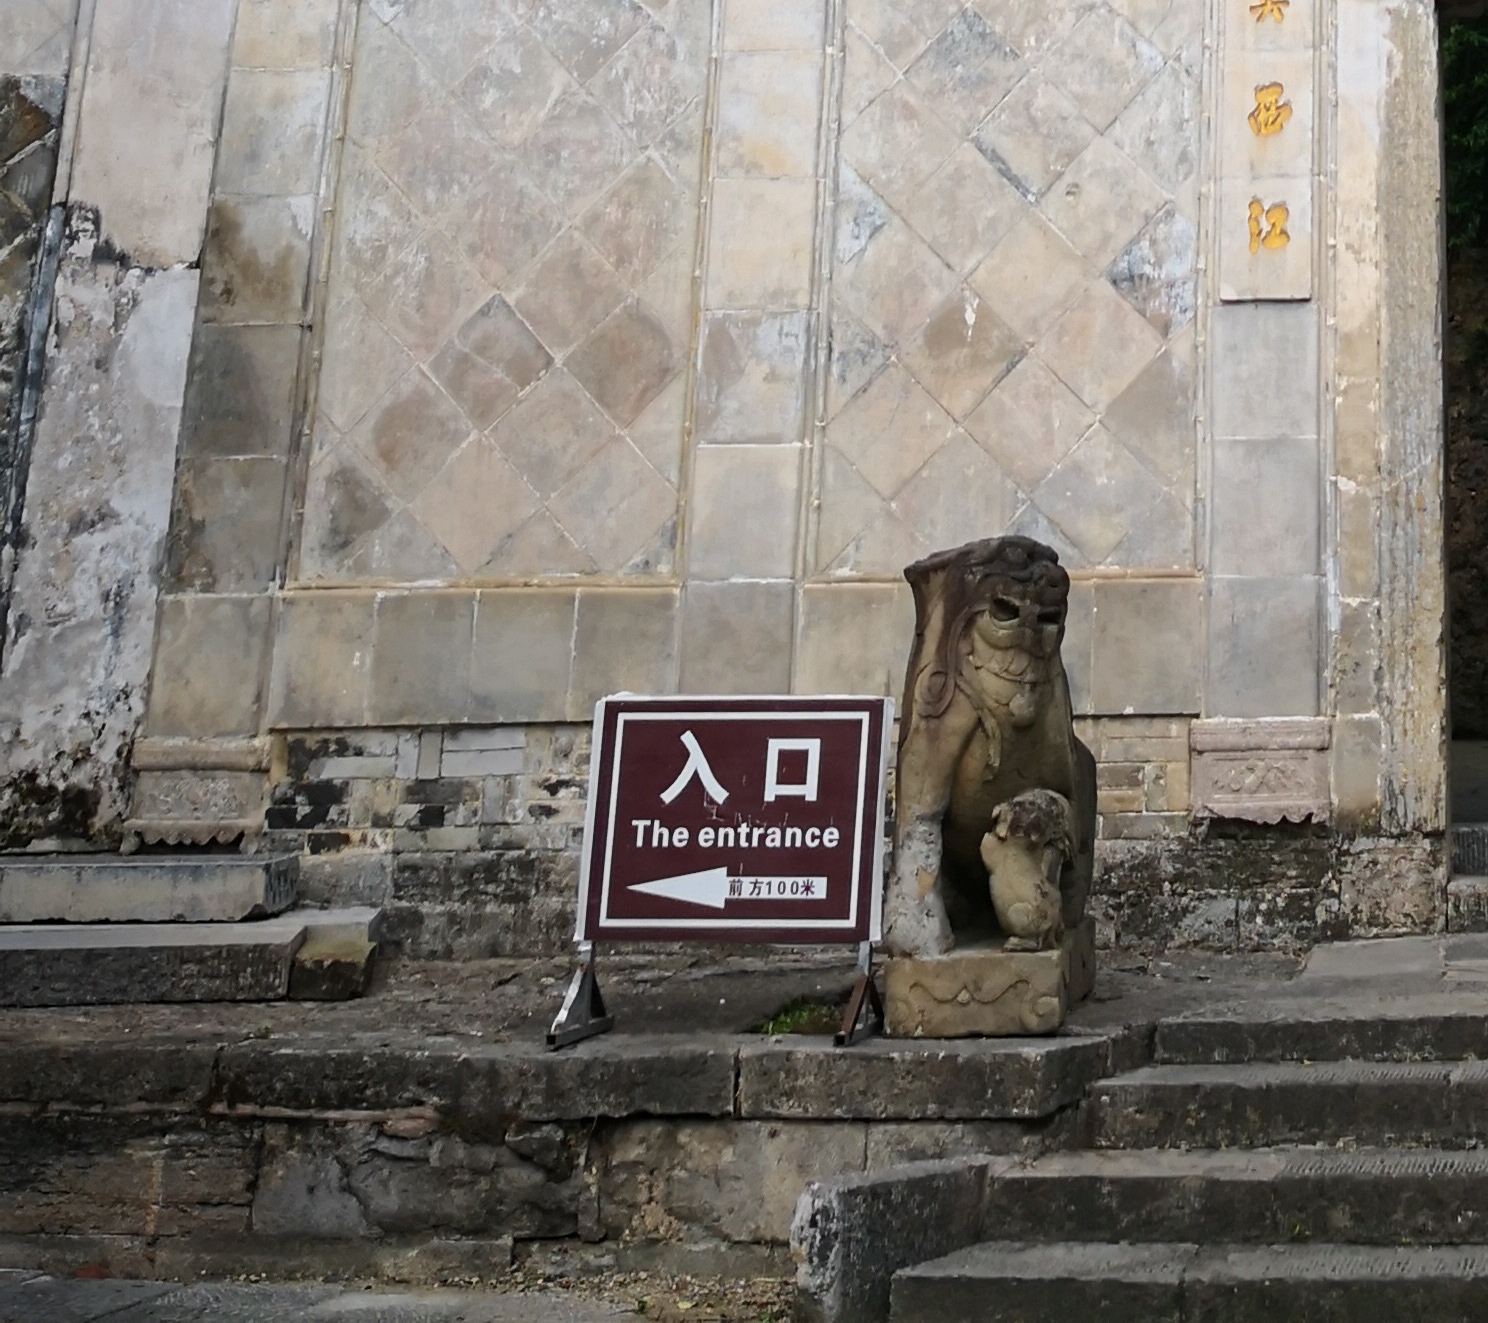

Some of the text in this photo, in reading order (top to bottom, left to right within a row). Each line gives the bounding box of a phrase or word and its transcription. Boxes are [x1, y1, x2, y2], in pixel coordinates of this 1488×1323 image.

[660, 730, 821, 805] 入口
[632, 819, 840, 849] The entrance
[728, 878, 816, 898] 前方100米
